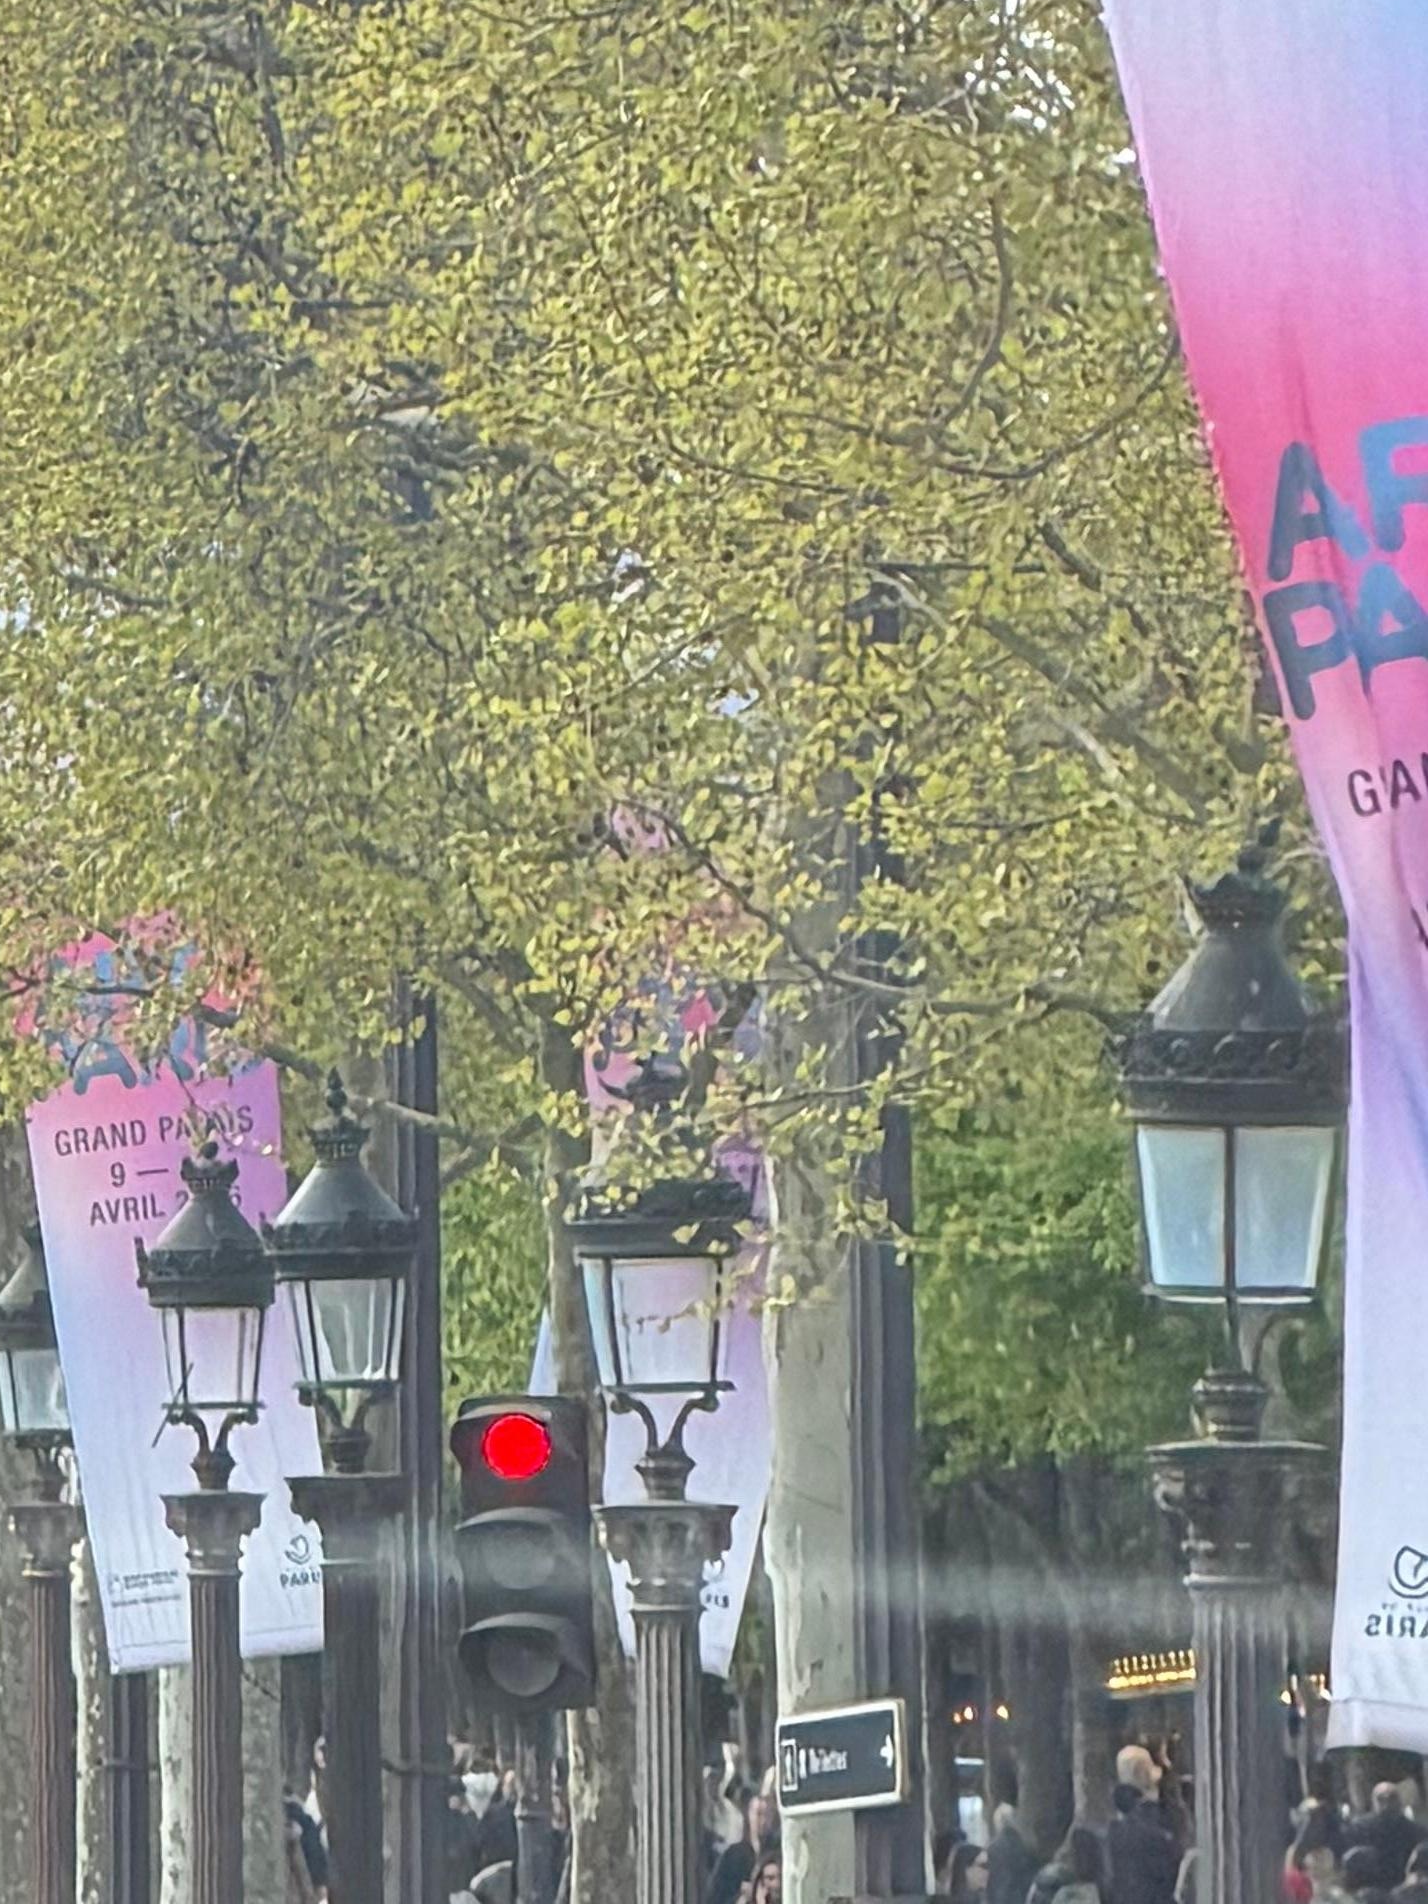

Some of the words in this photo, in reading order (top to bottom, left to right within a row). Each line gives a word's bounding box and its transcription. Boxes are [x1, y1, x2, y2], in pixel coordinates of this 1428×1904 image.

[55, 1120, 145, 1156] GRAND
[110, 1162, 125, 1187] 9
[90, 1193, 166, 1226] AVRIL
